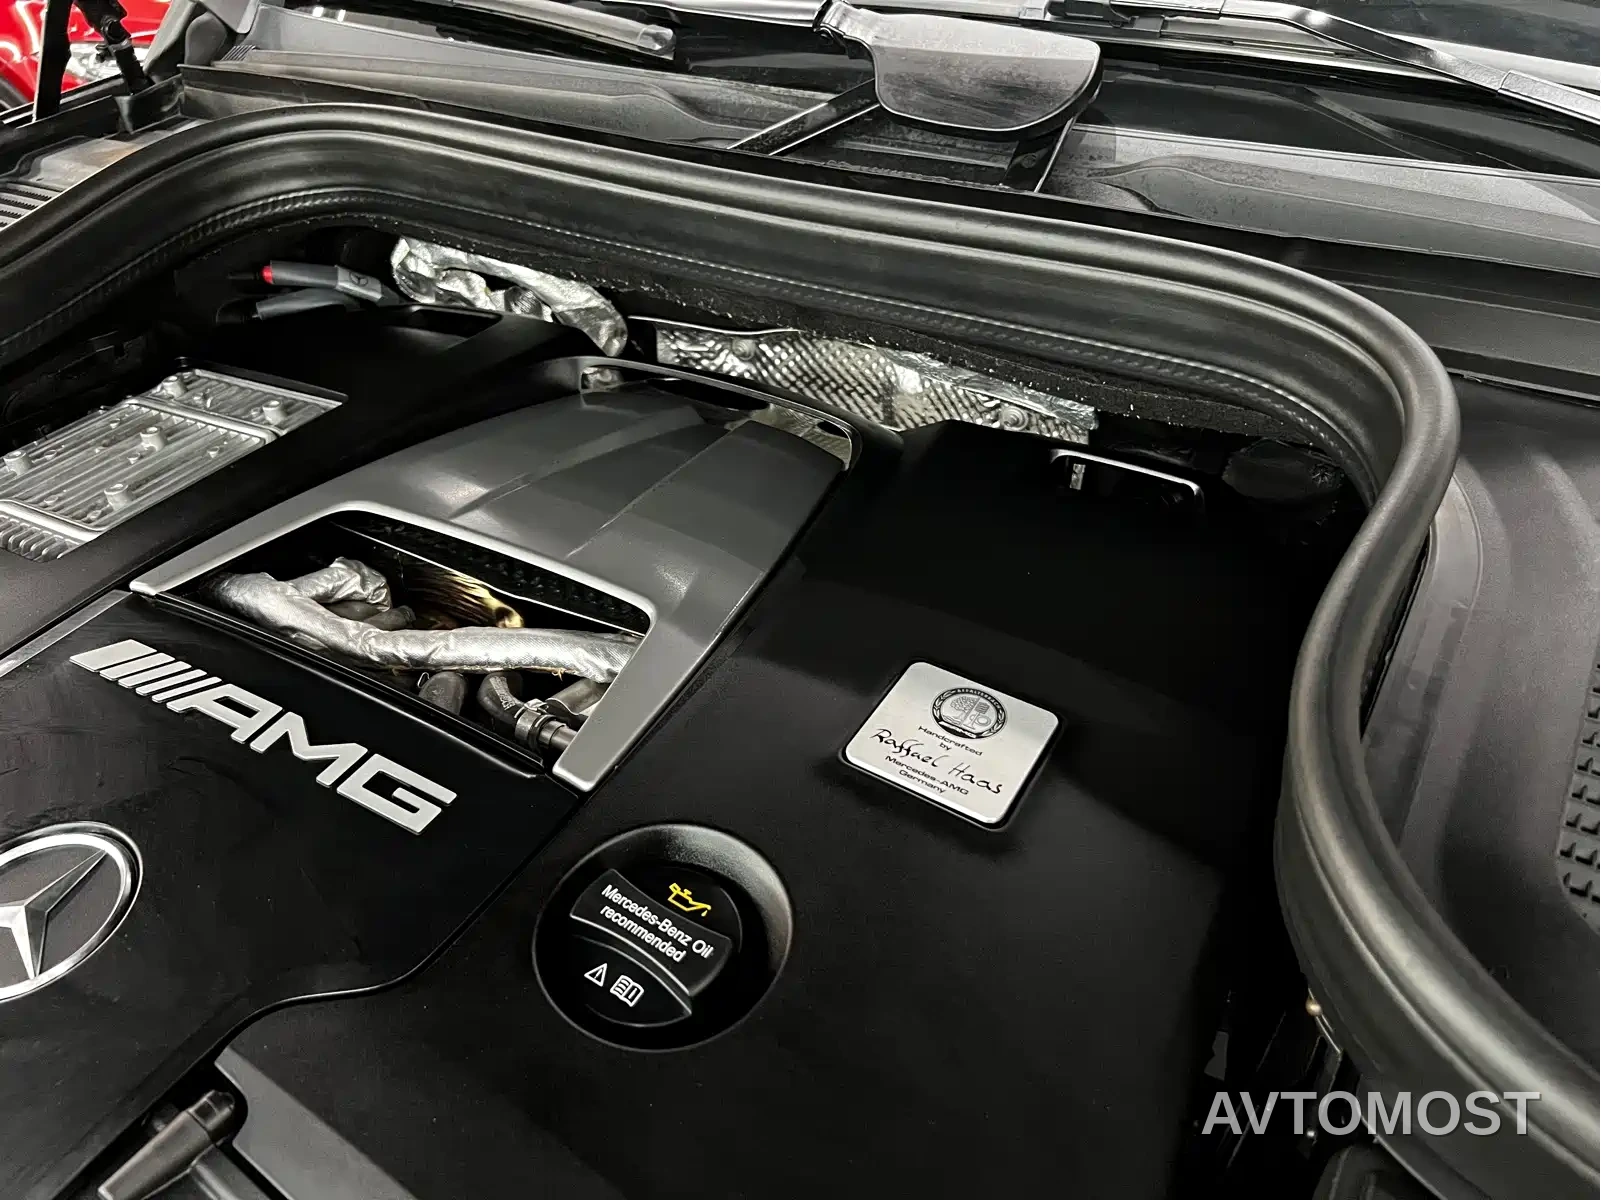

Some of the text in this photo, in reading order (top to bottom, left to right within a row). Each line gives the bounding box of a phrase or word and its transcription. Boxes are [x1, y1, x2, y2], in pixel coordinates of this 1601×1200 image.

[166, 683, 458, 837] AMG
[869, 728, 950, 768] Raffael
[947, 762, 1003, 795] Haas
[918, 725, 983, 756] Handcrafted
[939, 742, 952, 752] by
[885, 755, 970, 796] Mercedes-AMG
[899, 769, 947, 794] Germany
[600, 905, 687, 963] recommended
[601, 884, 714, 959] Mercedes-Benz Oil
